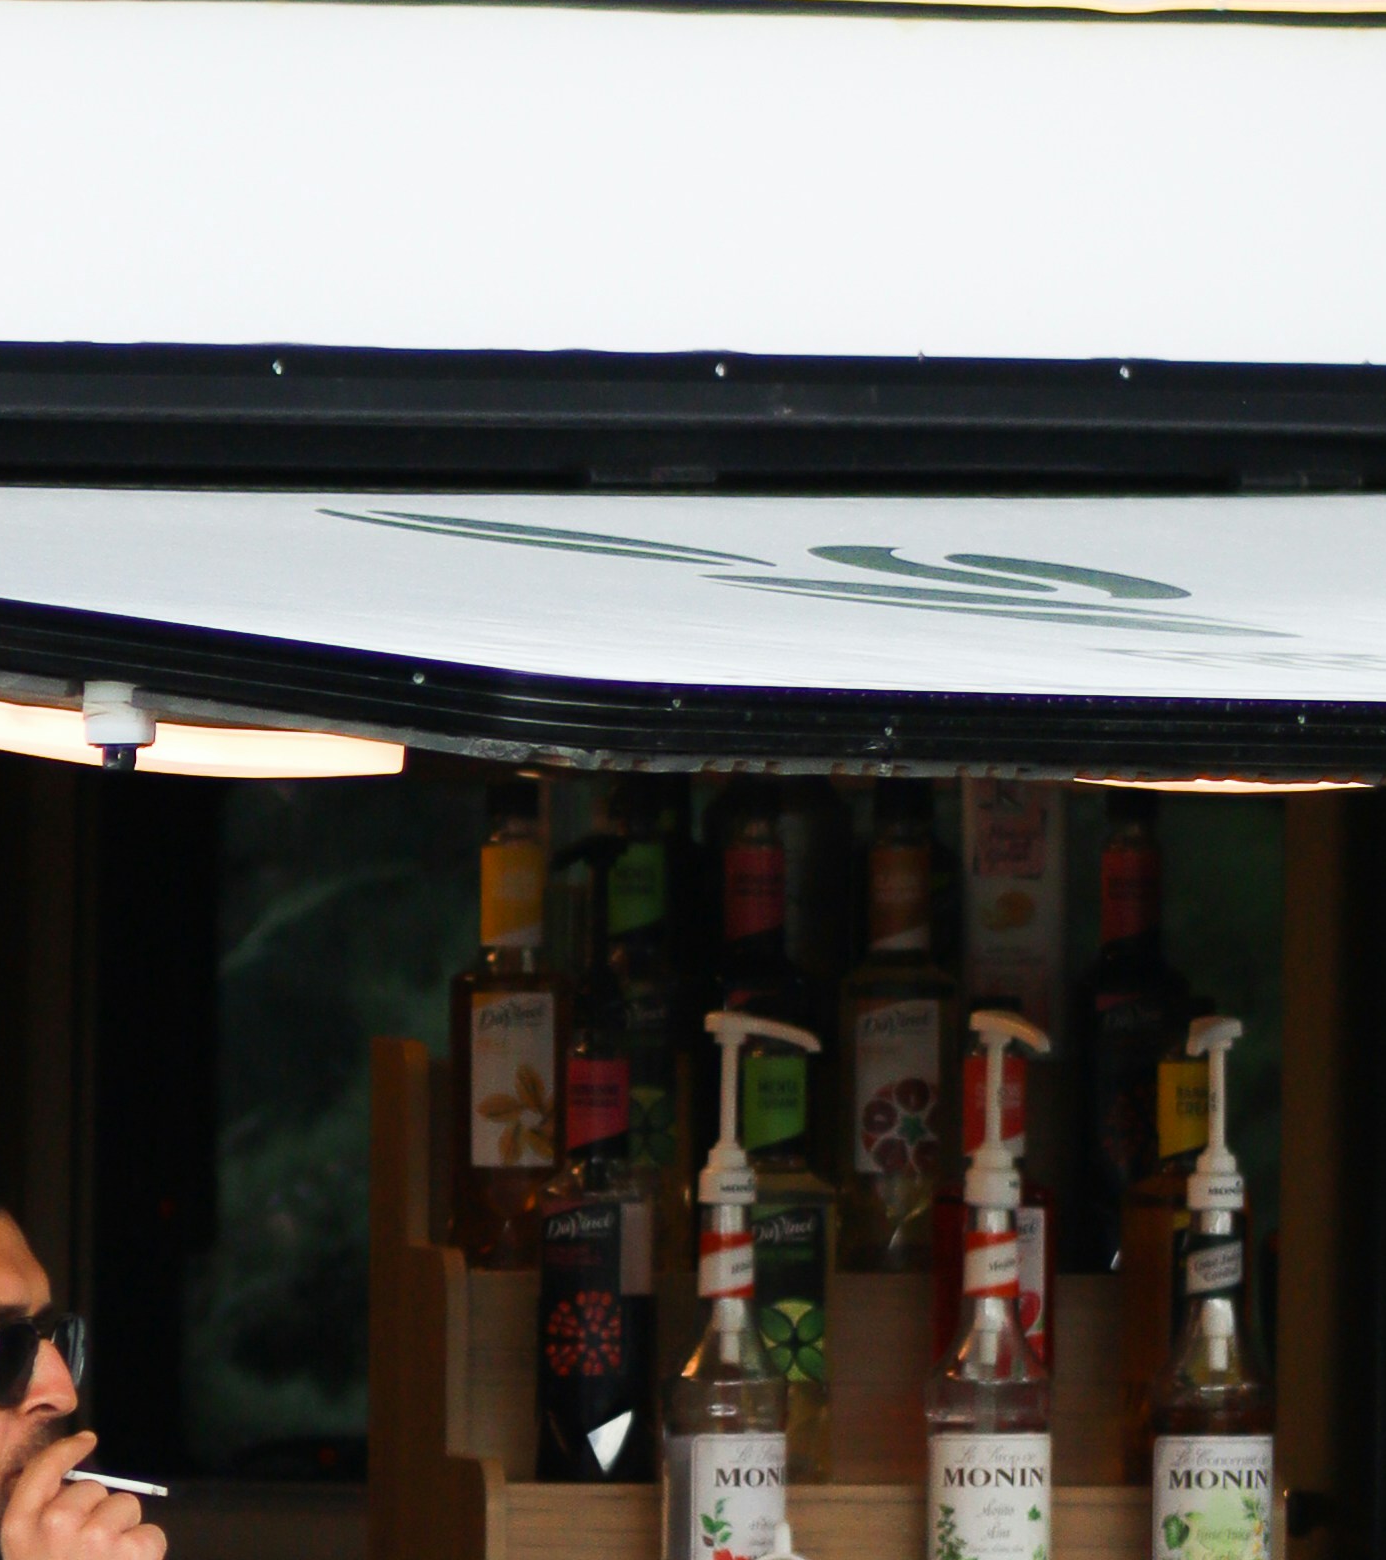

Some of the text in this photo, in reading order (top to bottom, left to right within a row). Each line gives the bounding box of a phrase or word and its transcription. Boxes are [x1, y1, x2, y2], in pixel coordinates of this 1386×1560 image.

[714, 1467, 781, 1489] MON
[943, 1467, 1045, 1488] MONIN
[1168, 1468, 1269, 1490] MONIN
